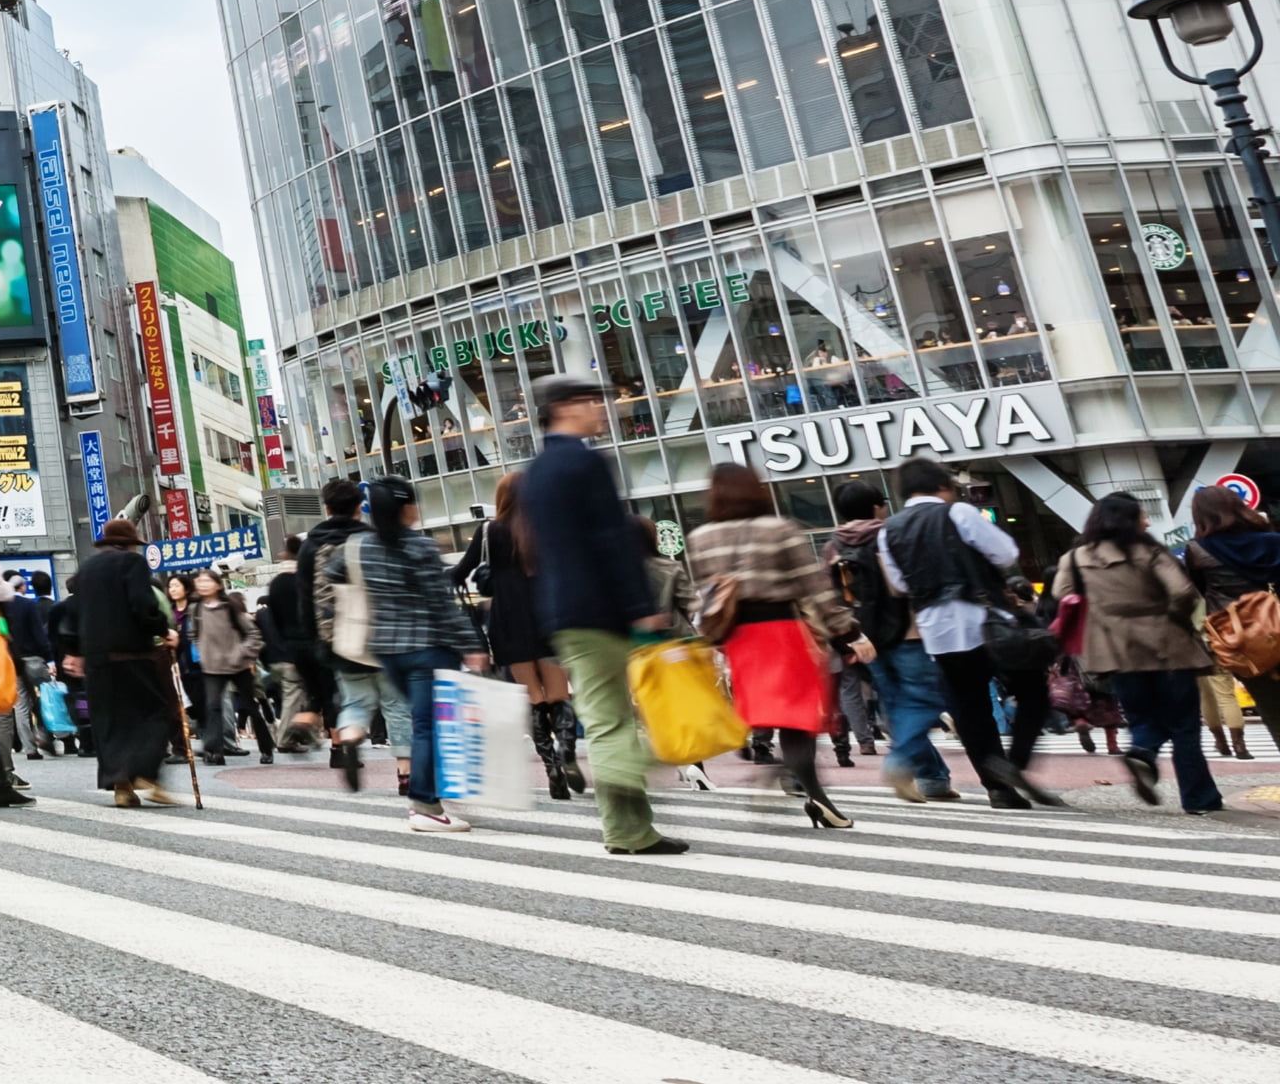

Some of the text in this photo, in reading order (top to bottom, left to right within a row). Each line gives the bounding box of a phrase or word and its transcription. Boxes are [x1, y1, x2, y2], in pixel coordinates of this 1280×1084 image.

[38, 139, 78, 324] Taisei neon
[591, 272, 750, 333] COFFEE
[11, 392, 21, 406] 2
[140, 286, 180, 465] クスリのことなら 三千里
[17, 446, 27, 460] 2
[717, 393, 1053, 472] TSUTAYA
[161, 528, 257, 561] 歩きタバコ禁止
[170, 505, 192, 540] 七輪
